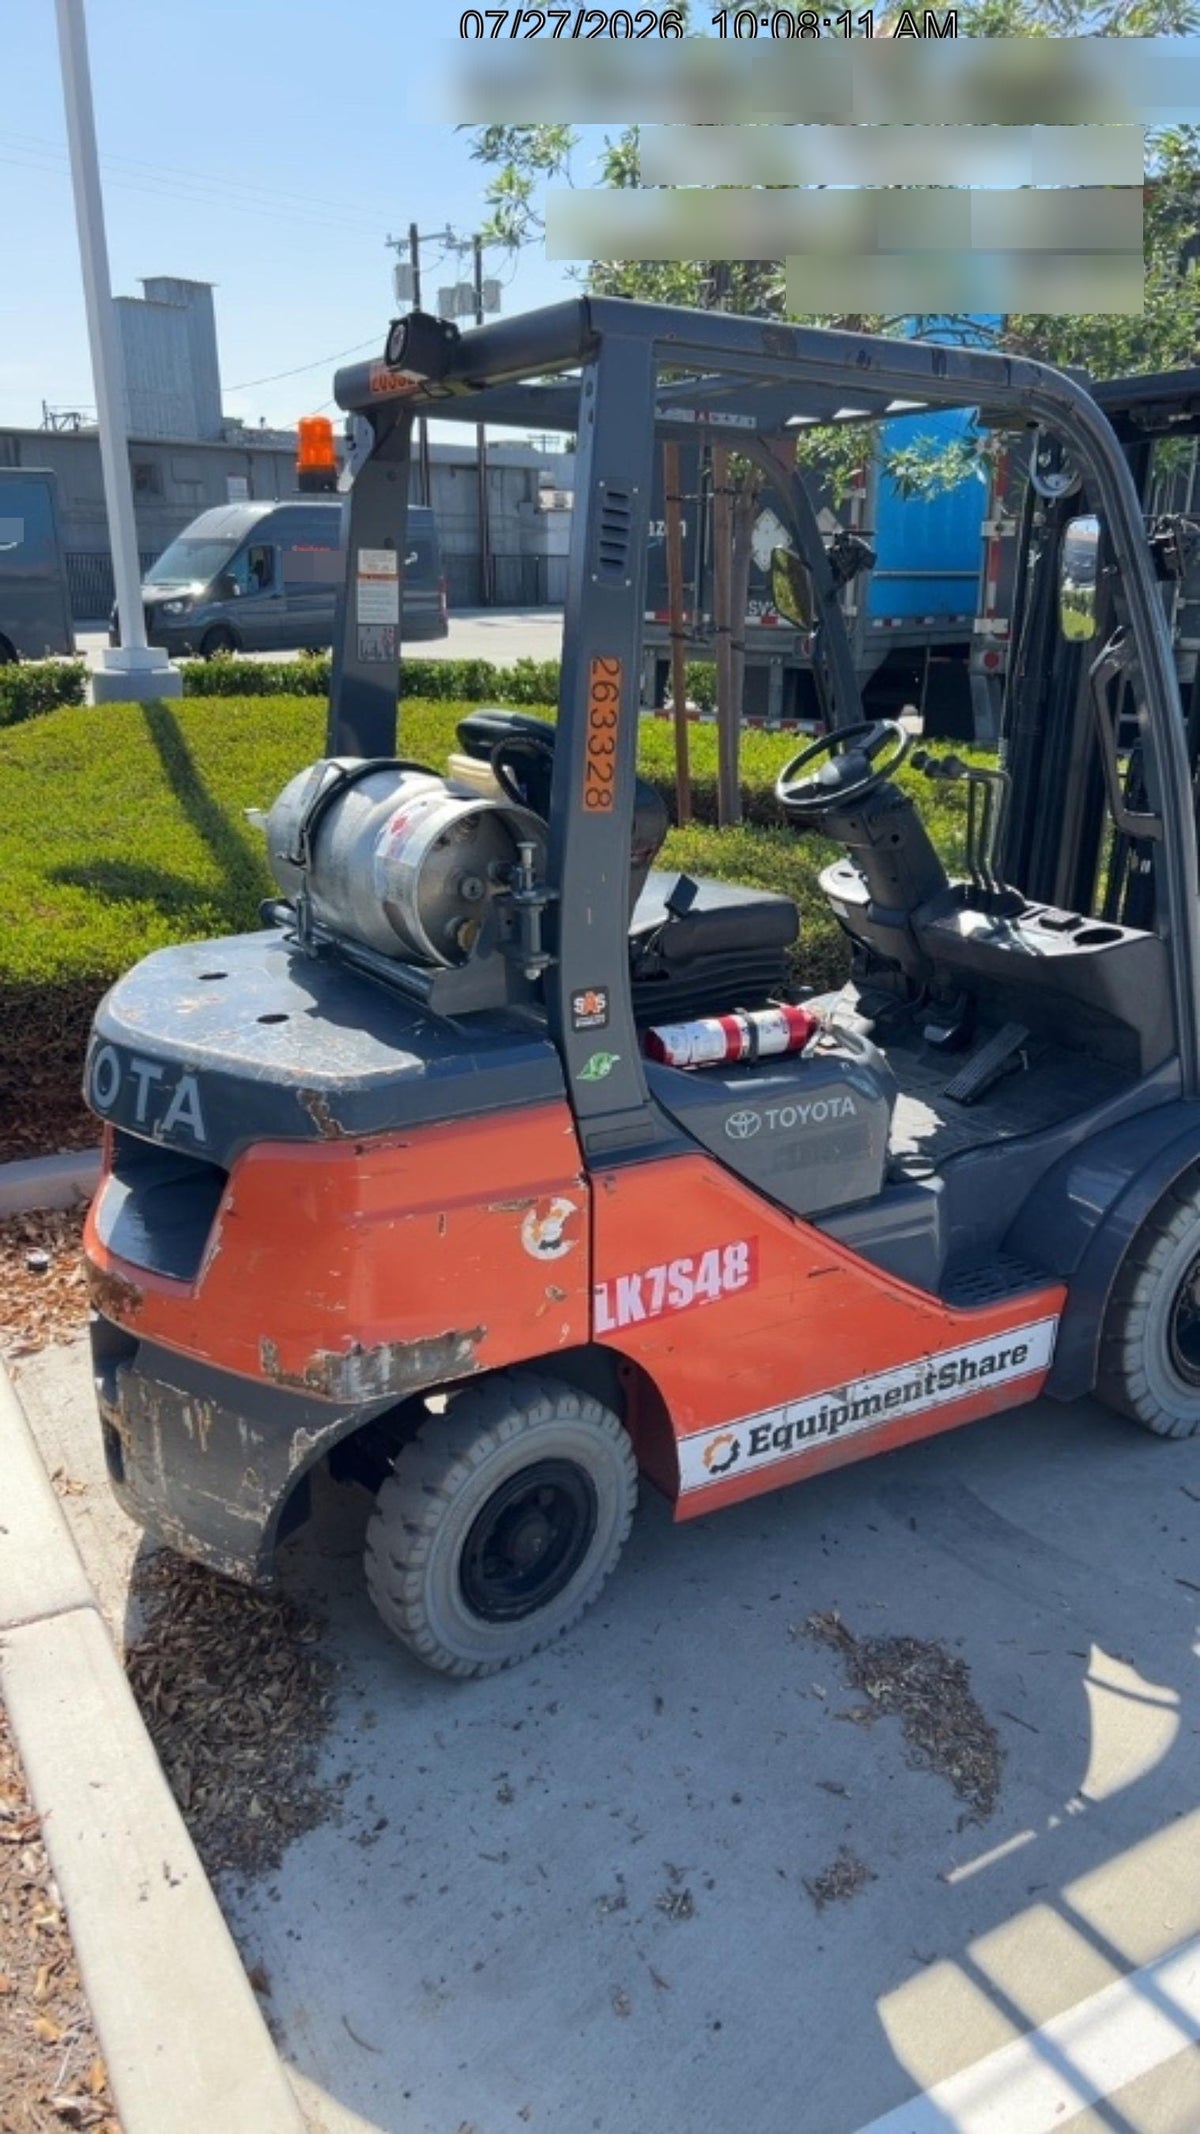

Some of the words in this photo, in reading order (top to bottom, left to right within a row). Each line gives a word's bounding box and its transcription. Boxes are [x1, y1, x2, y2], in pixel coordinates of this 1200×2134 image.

[585, 656, 620, 808] 263328
[765, 1096, 856, 1130] TOYOTA
[594, 1241, 749, 1334] LK7S48
[746, 1343, 1028, 1457] EquipmentShare
